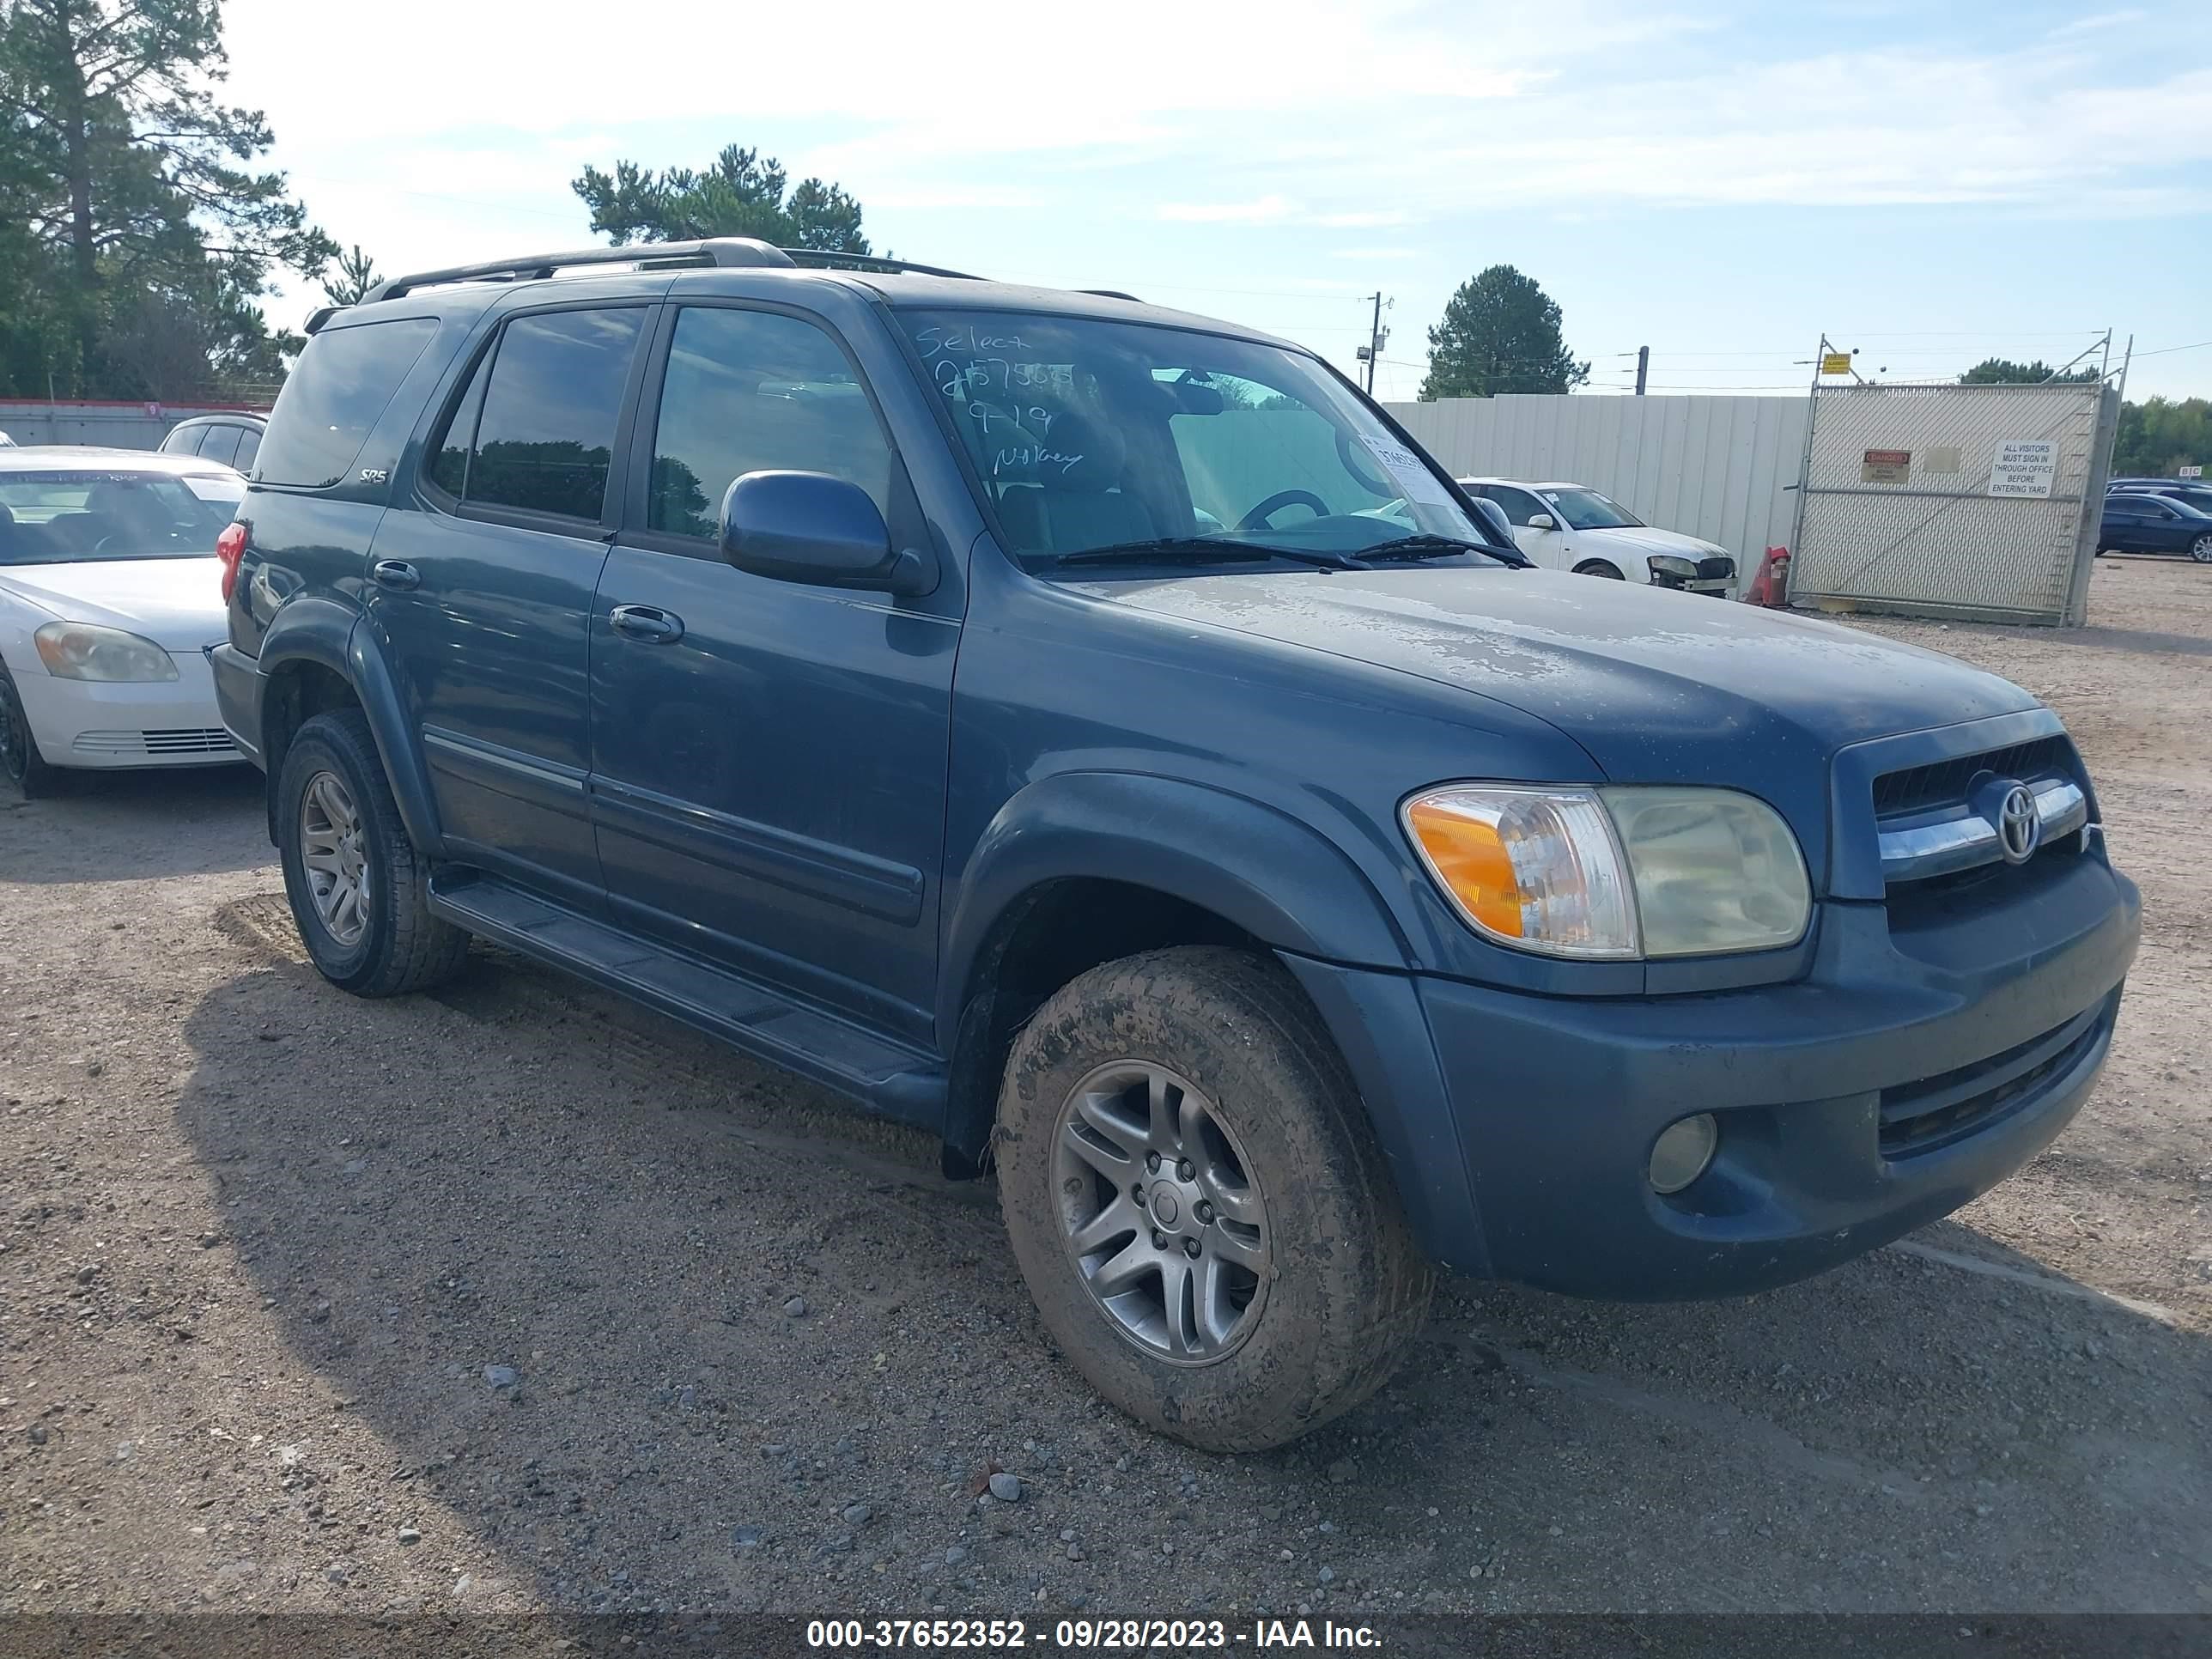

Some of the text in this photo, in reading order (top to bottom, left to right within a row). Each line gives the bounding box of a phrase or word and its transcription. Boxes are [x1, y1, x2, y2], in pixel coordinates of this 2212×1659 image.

[969, 401, 1054, 433] 9-19
[2023, 454, 2039, 463] SIGN
[2028, 465, 2054, 474] OFFICE
[360, 468, 387, 483] SR5
[2007, 474, 2036, 483] BEFORE
[1992, 484, 2047, 494] ENTERING YARD
